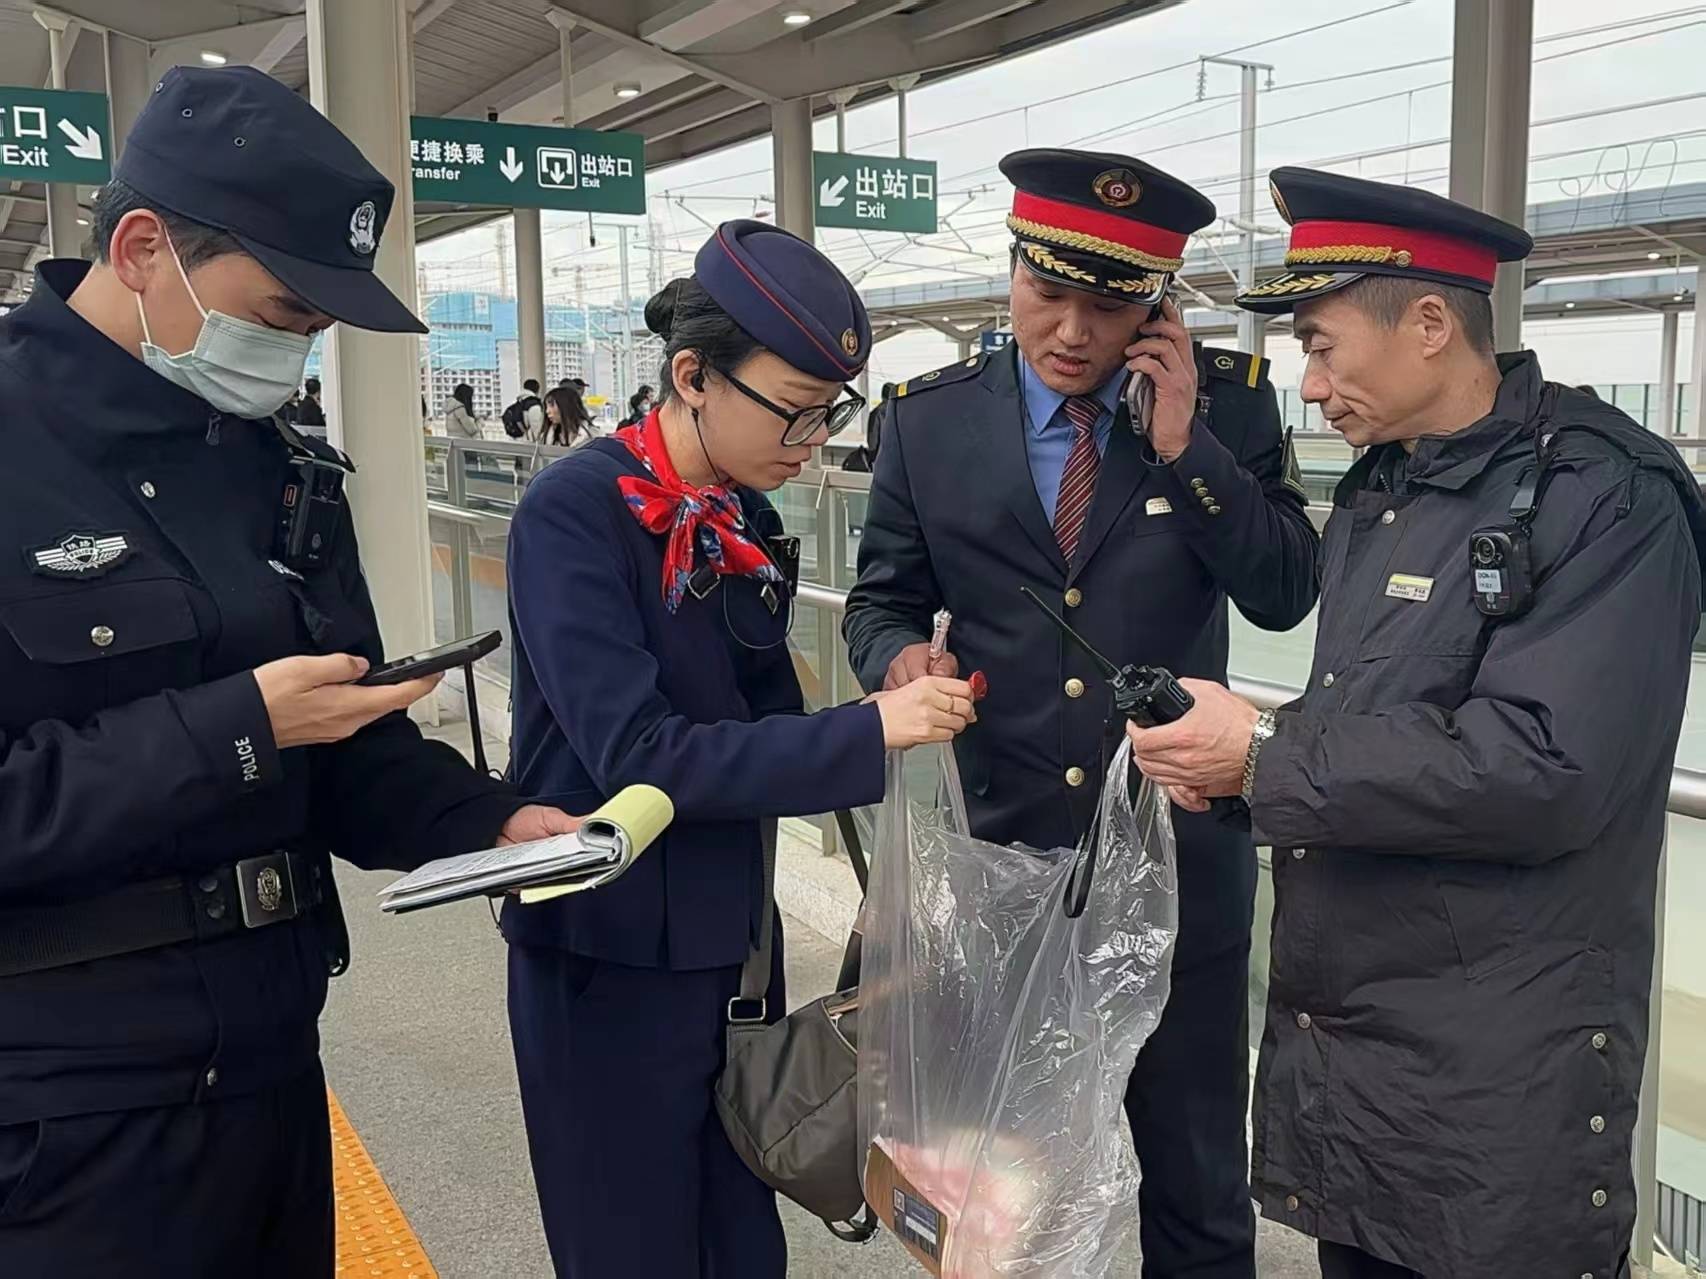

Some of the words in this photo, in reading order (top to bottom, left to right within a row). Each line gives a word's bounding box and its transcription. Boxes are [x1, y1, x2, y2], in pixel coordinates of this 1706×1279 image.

[0, 106, 47, 139] 口
[3, 144, 49, 167] Exit
[581, 153, 633, 177] 出站口
[412, 166, 460, 180] ansfer
[582, 177, 600, 188] Exit
[856, 166, 933, 200] 出站口
[856, 200, 886, 219] Exit
[235, 736, 259, 781] POLICE
